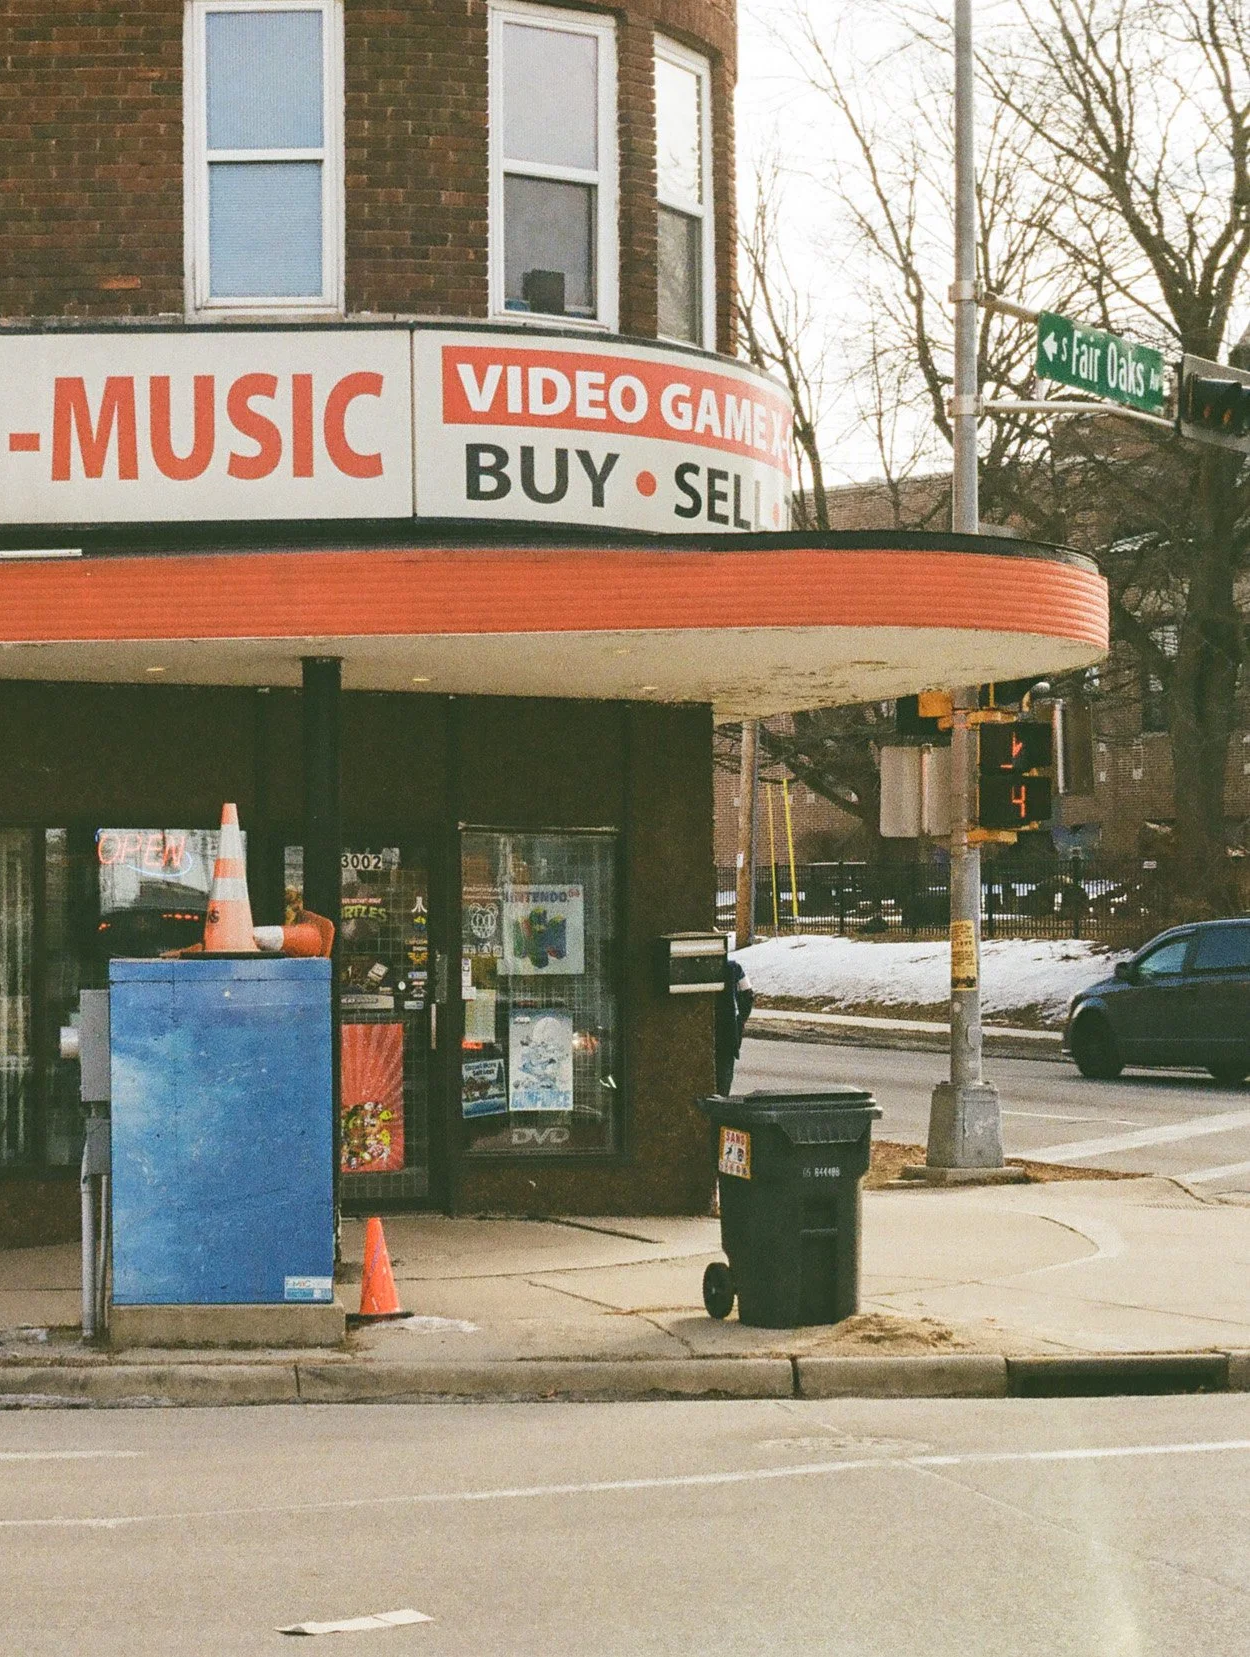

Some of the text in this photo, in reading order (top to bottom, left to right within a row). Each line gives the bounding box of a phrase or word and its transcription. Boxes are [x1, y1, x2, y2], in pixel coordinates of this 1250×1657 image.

[1061, 337, 1068, 362] S
[1071, 329, 1100, 383] Fair
[1107, 341, 1145, 397] Oaks
[456, 363, 649, 424] VIDEO
[660, 382, 767, 452] GAME
[465, 442, 620, 509] BUY
[674, 461, 766, 532] SELL
[1011, 784, 1026, 818] 4
[97, 833, 188, 868] OPEN
[341, 854, 382, 869] 3002
[511, 1127, 570, 1144] DVD
